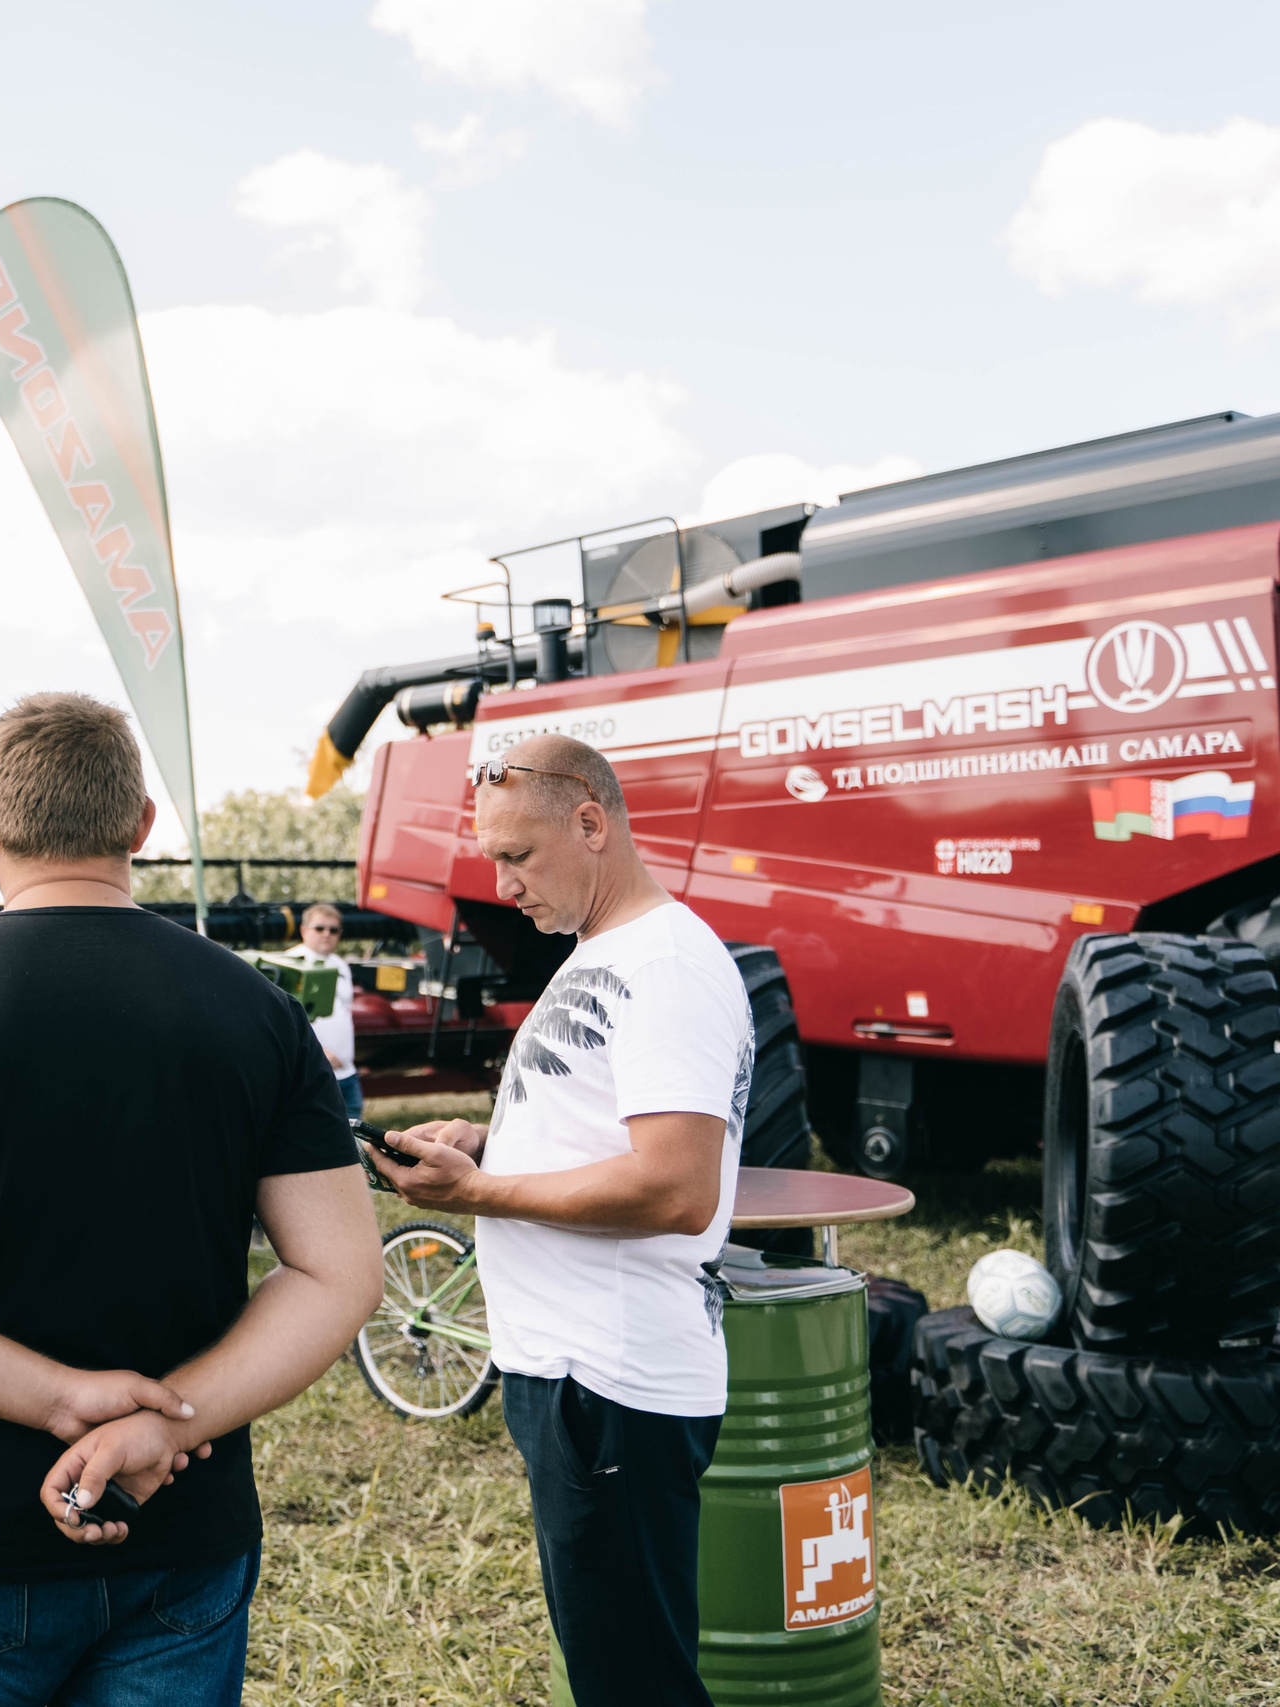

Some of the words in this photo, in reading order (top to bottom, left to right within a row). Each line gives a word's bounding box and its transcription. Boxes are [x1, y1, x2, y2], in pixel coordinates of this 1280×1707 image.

[571, 718, 617, 740] PRO
[740, 684, 1068, 758] GOMSELMASH
[832, 765, 864, 791] ТД
[867, 741, 1109, 786] ПОДШИПНИКМАШ
[1119, 729, 1243, 762] САМАРА
[790, 1588, 875, 1624] AMAZONE
